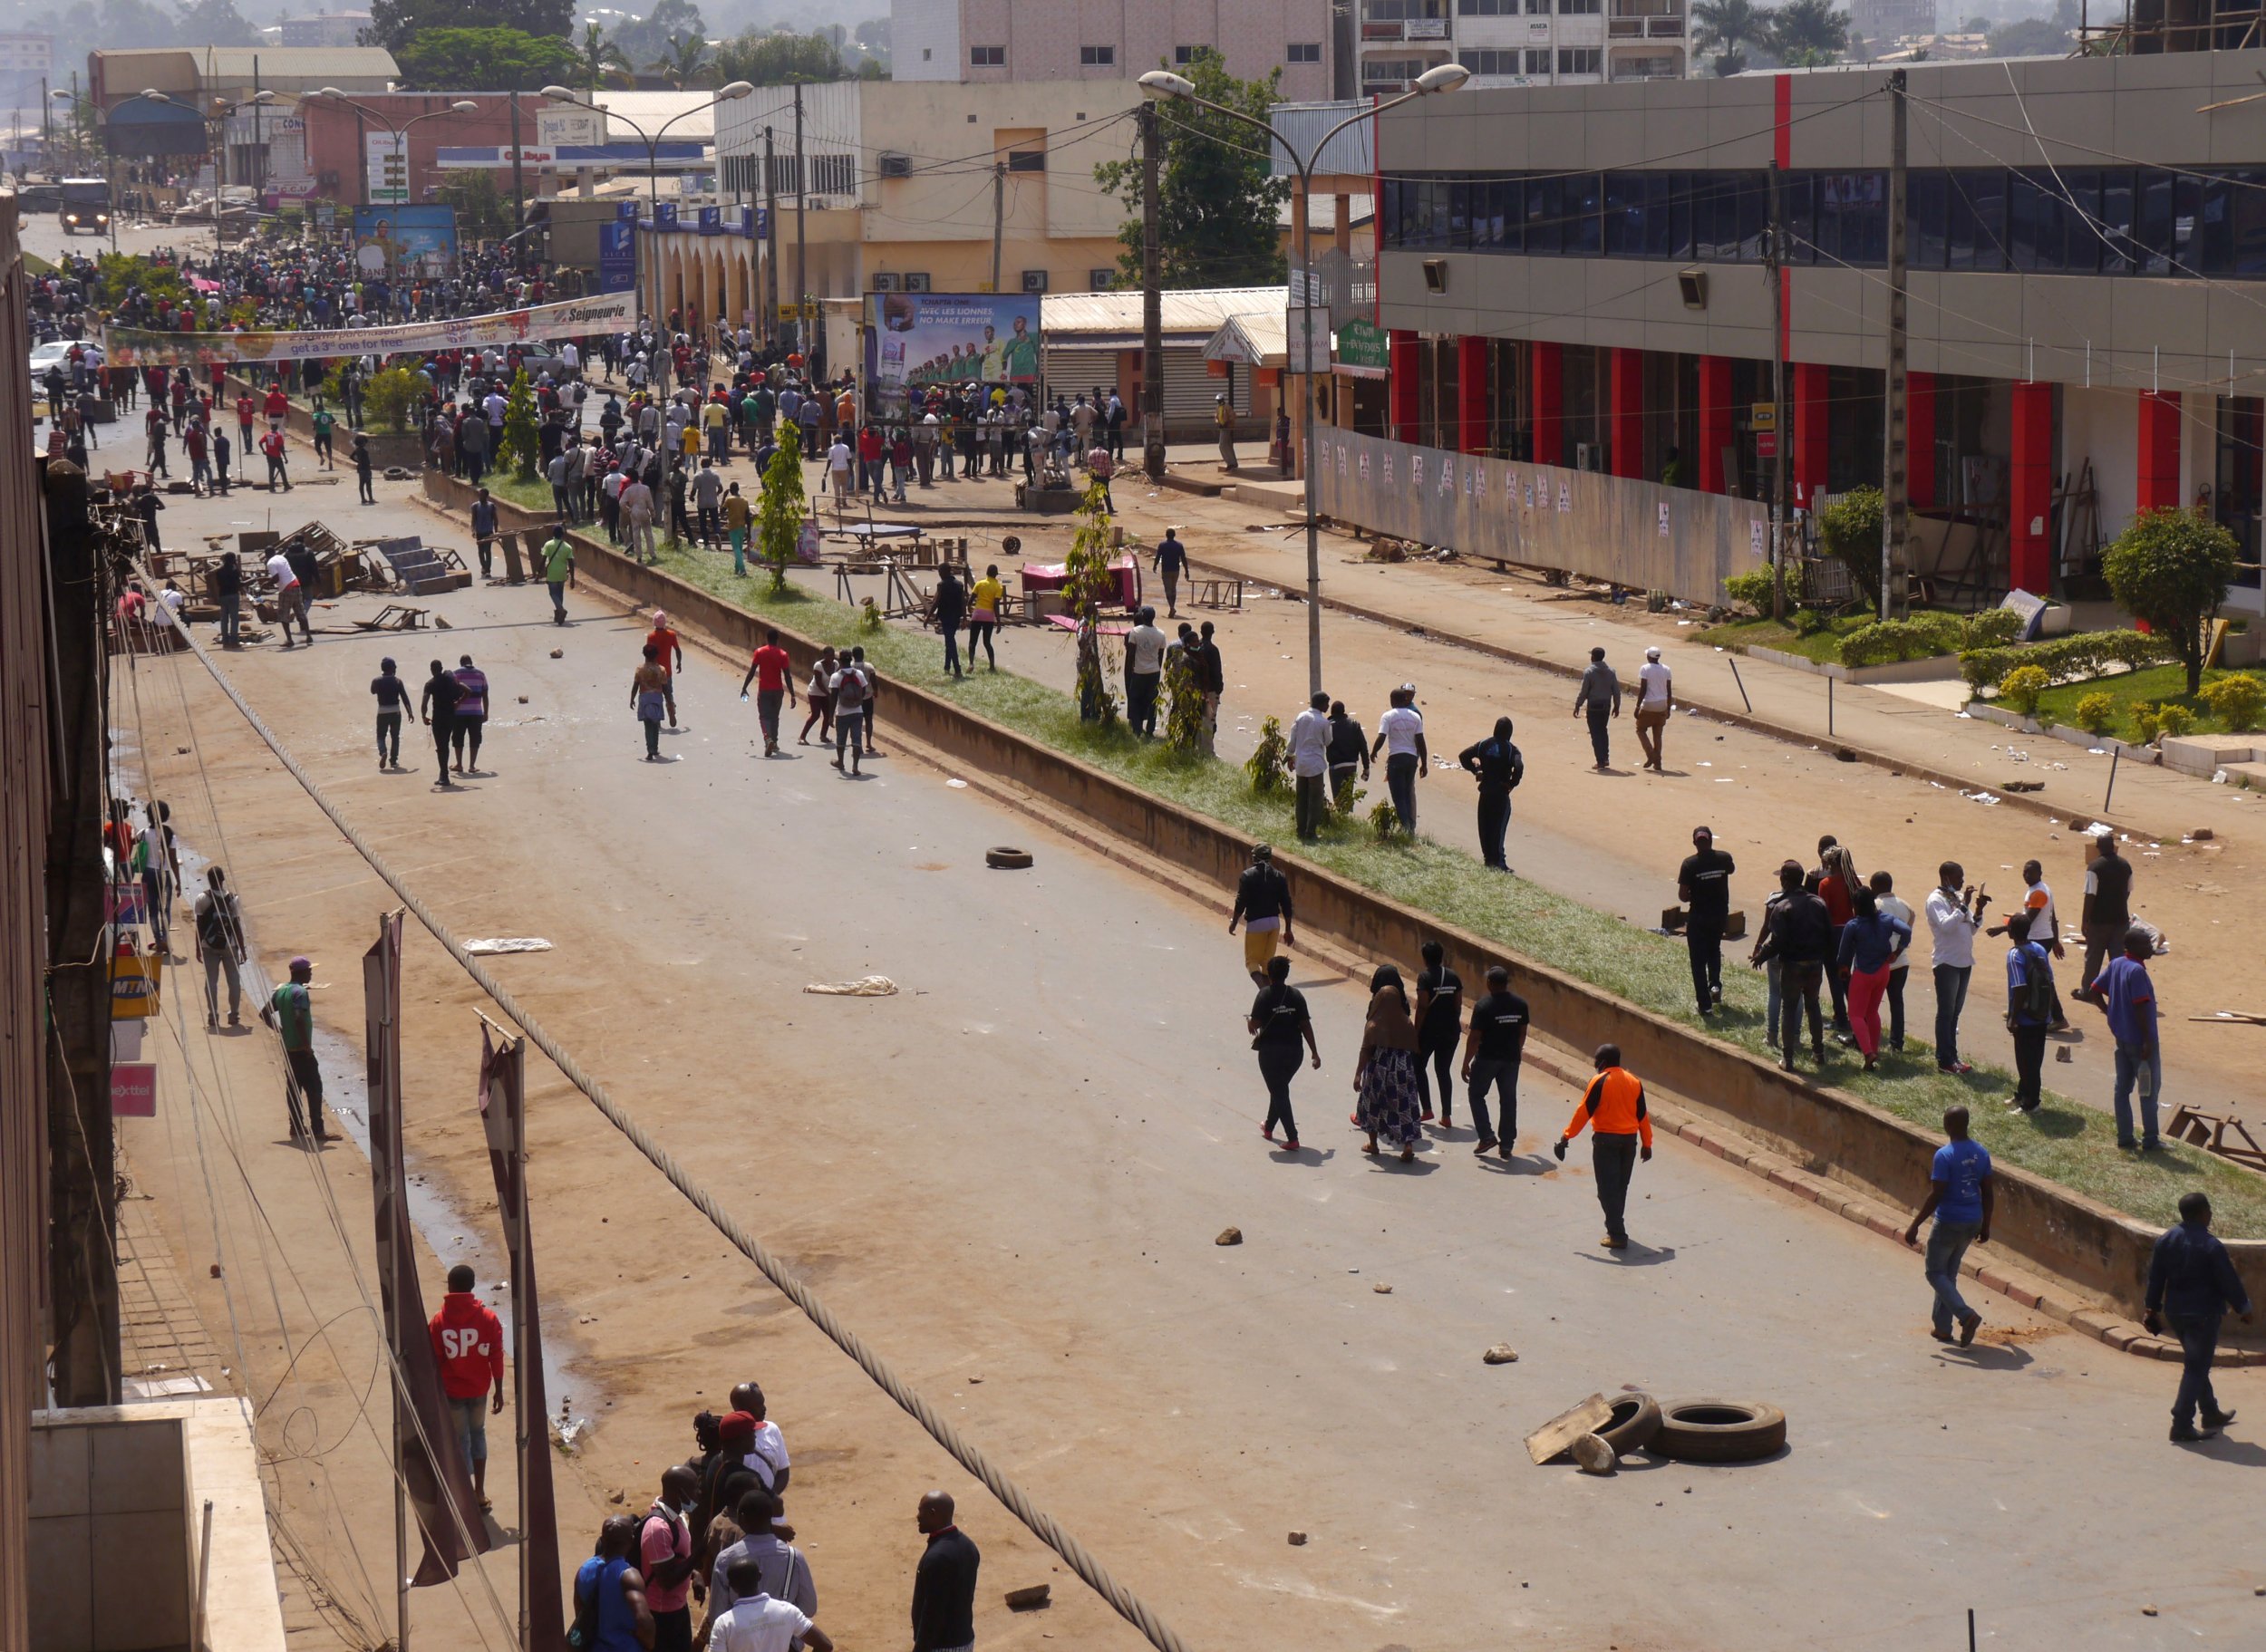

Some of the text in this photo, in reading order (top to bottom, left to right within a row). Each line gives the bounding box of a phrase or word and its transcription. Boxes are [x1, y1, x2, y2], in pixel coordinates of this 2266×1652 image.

[568, 304, 625, 322] Seigneurie
[919, 307, 995, 316] AVEC LES LIONNES,
[919, 316, 934, 324] NO
[291, 343, 309, 355] get
[312, 344, 320, 353] a
[338, 341, 360, 351] one
[363, 339, 378, 349] for
[381, 338, 403, 348] free
[113, 981, 150, 994] MTN
